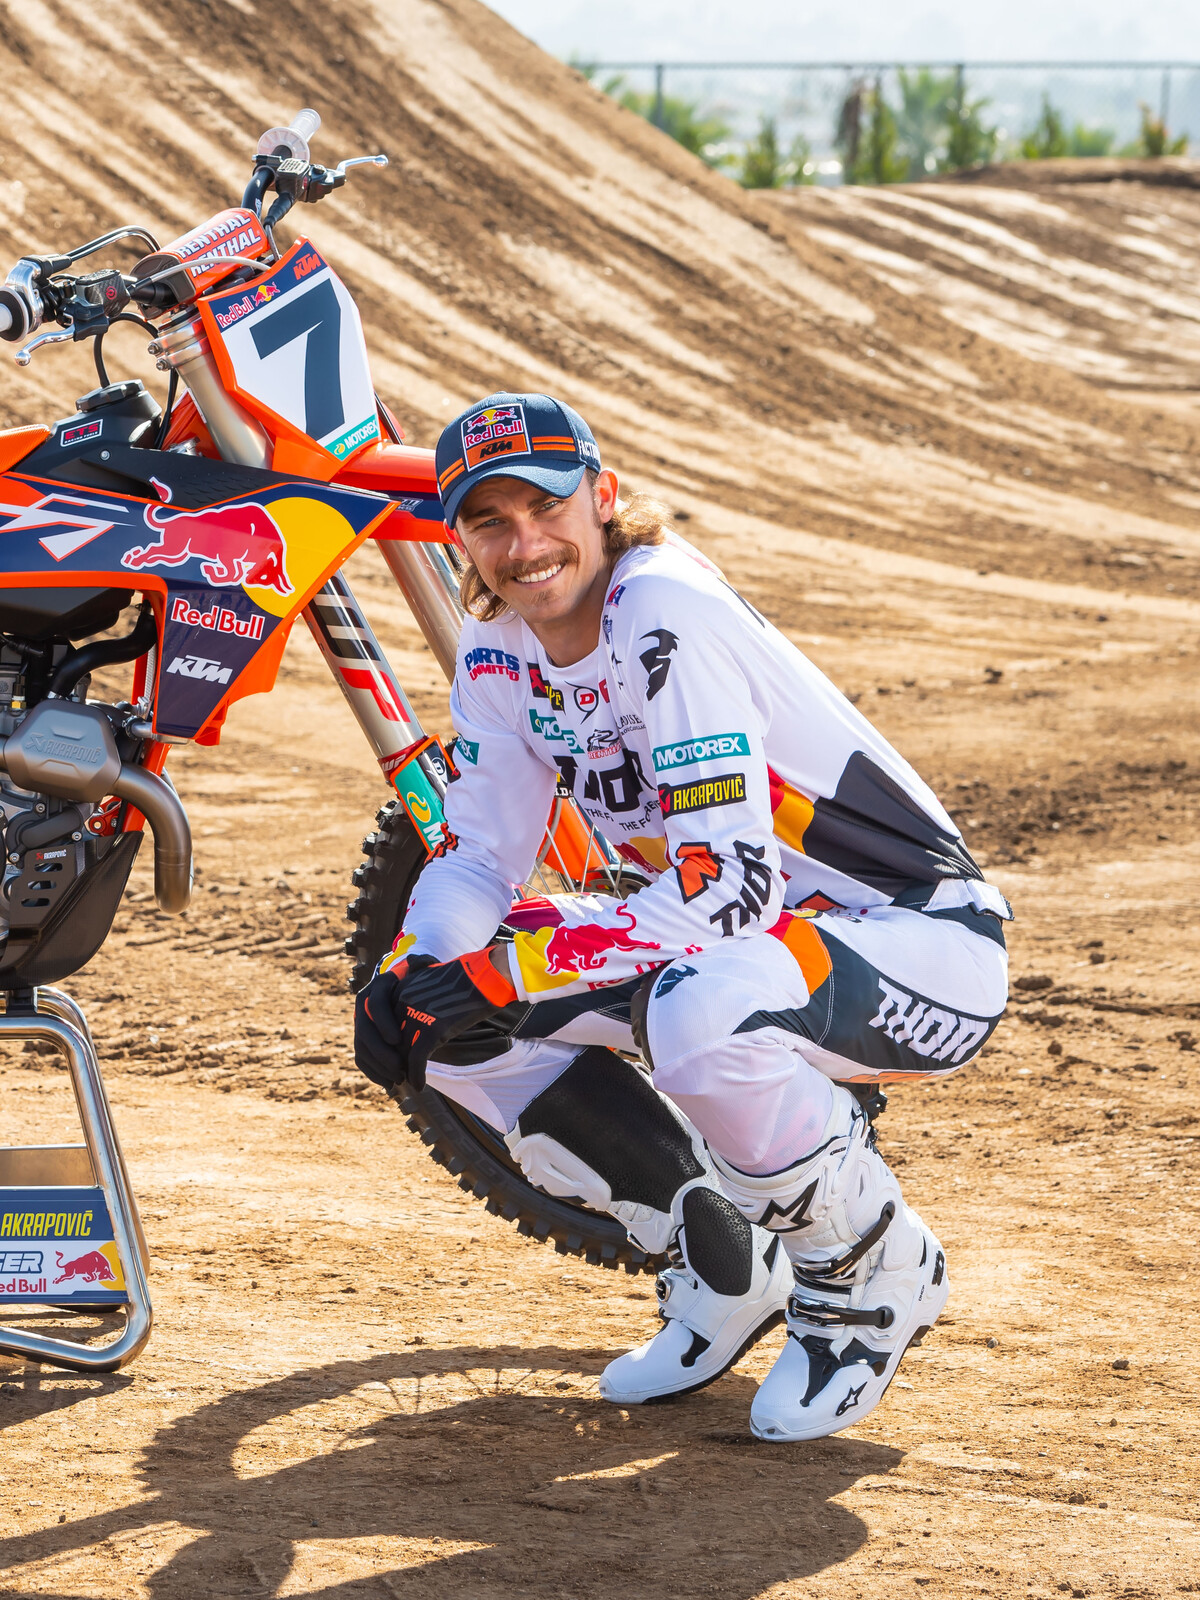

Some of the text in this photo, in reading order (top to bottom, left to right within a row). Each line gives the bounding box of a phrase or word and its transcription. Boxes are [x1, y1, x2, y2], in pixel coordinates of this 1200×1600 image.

[178, 213, 251, 259] RENTHAL
[293, 253, 322, 280] KTM
[249, 278, 345, 442] 7
[64, 422, 99, 440] ETS
[343, 420, 378, 449] MOTOREX
[465, 419, 523, 448] Red Bull
[480, 440, 513, 458] KTM
[171, 597, 265, 640] Red Bull
[166, 654, 233, 685] KTM
[464, 648, 520, 672] PARTS
[656, 736, 743, 768] MOTOREX
[406, 1006, 437, 1026] THOR
[867, 977, 990, 1063] THOR
[18, 1277, 48, 1294] Bull
